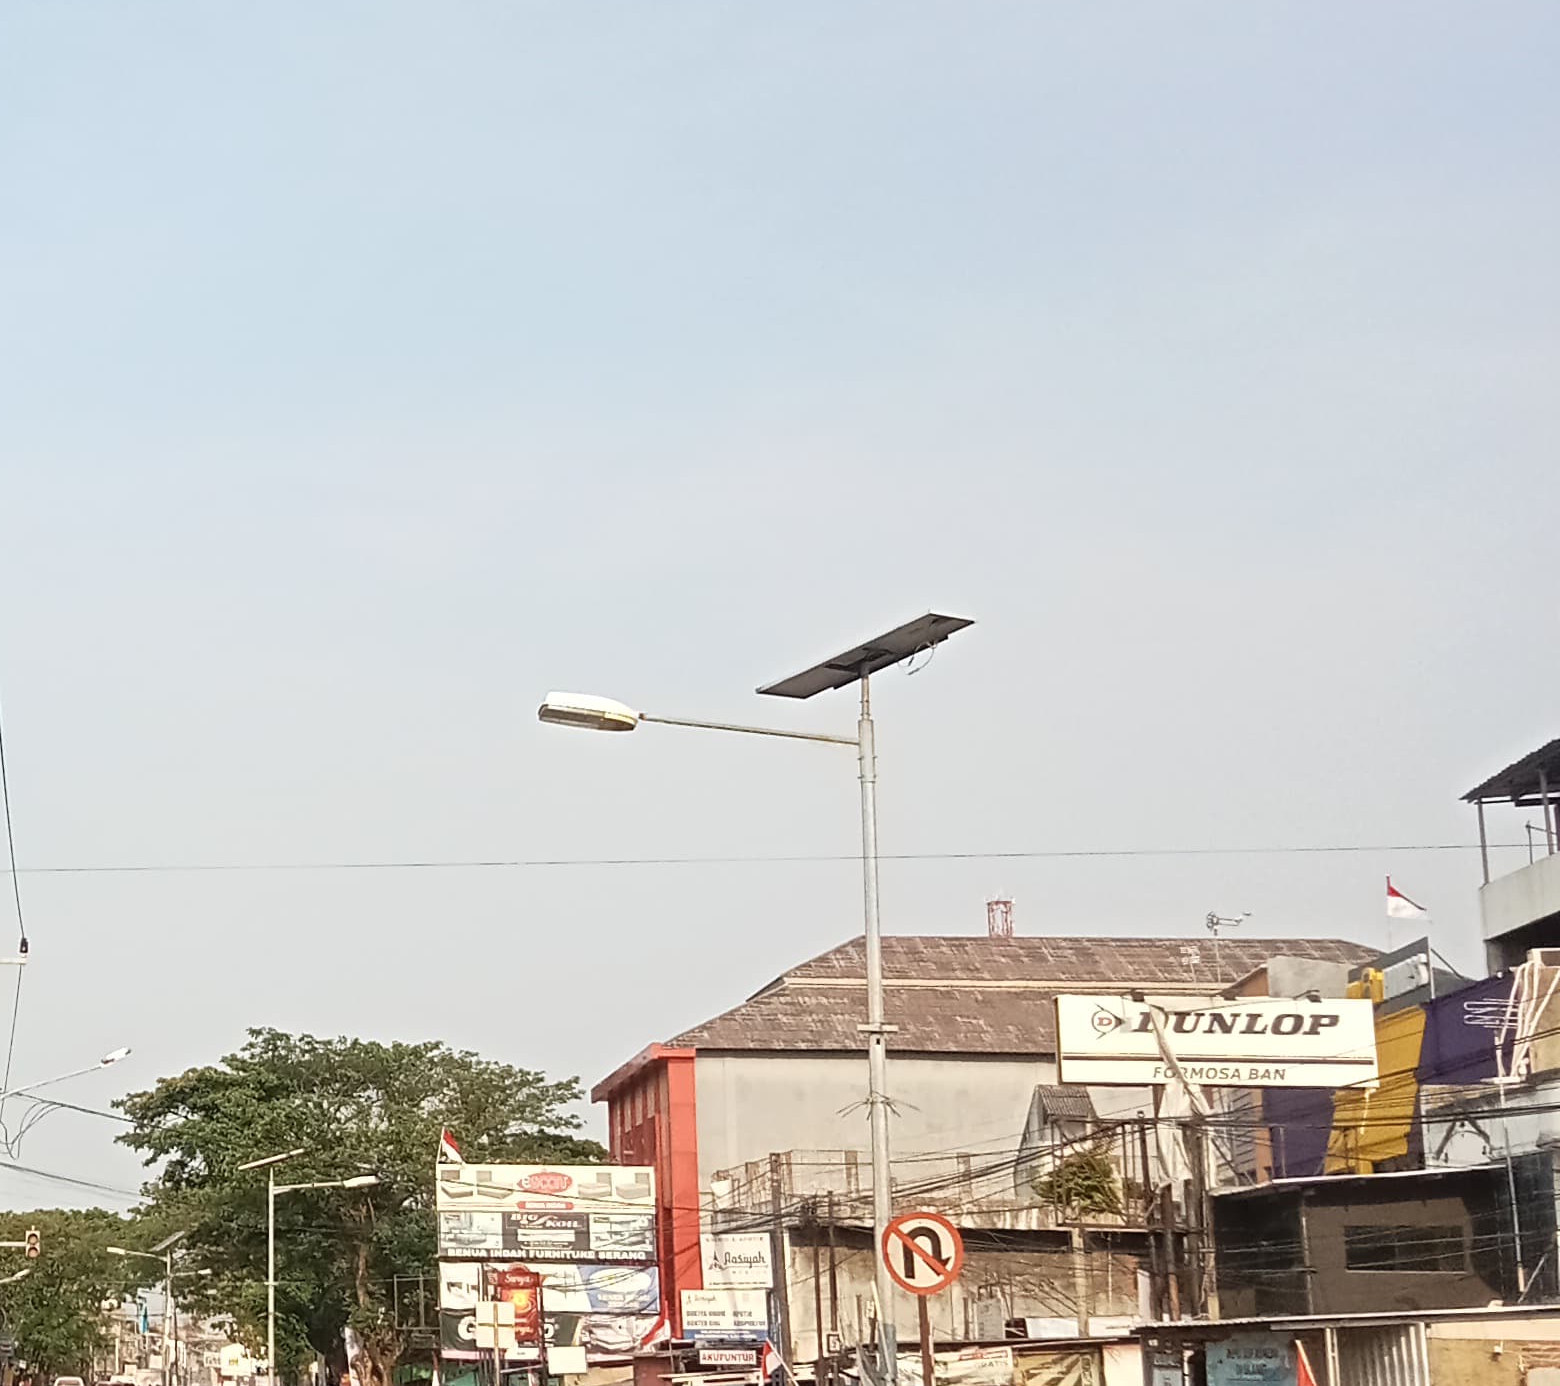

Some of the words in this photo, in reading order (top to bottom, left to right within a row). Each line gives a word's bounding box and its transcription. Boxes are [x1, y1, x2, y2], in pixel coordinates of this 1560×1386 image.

[1133, 1011, 1339, 1035] DUNLOP
[1152, 1066, 1241, 1080] FORMOSA
[1247, 1068, 1287, 1080] BAN
[447, 1248, 488, 1257] BENUA
[598, 1250, 647, 1261] SERANG
